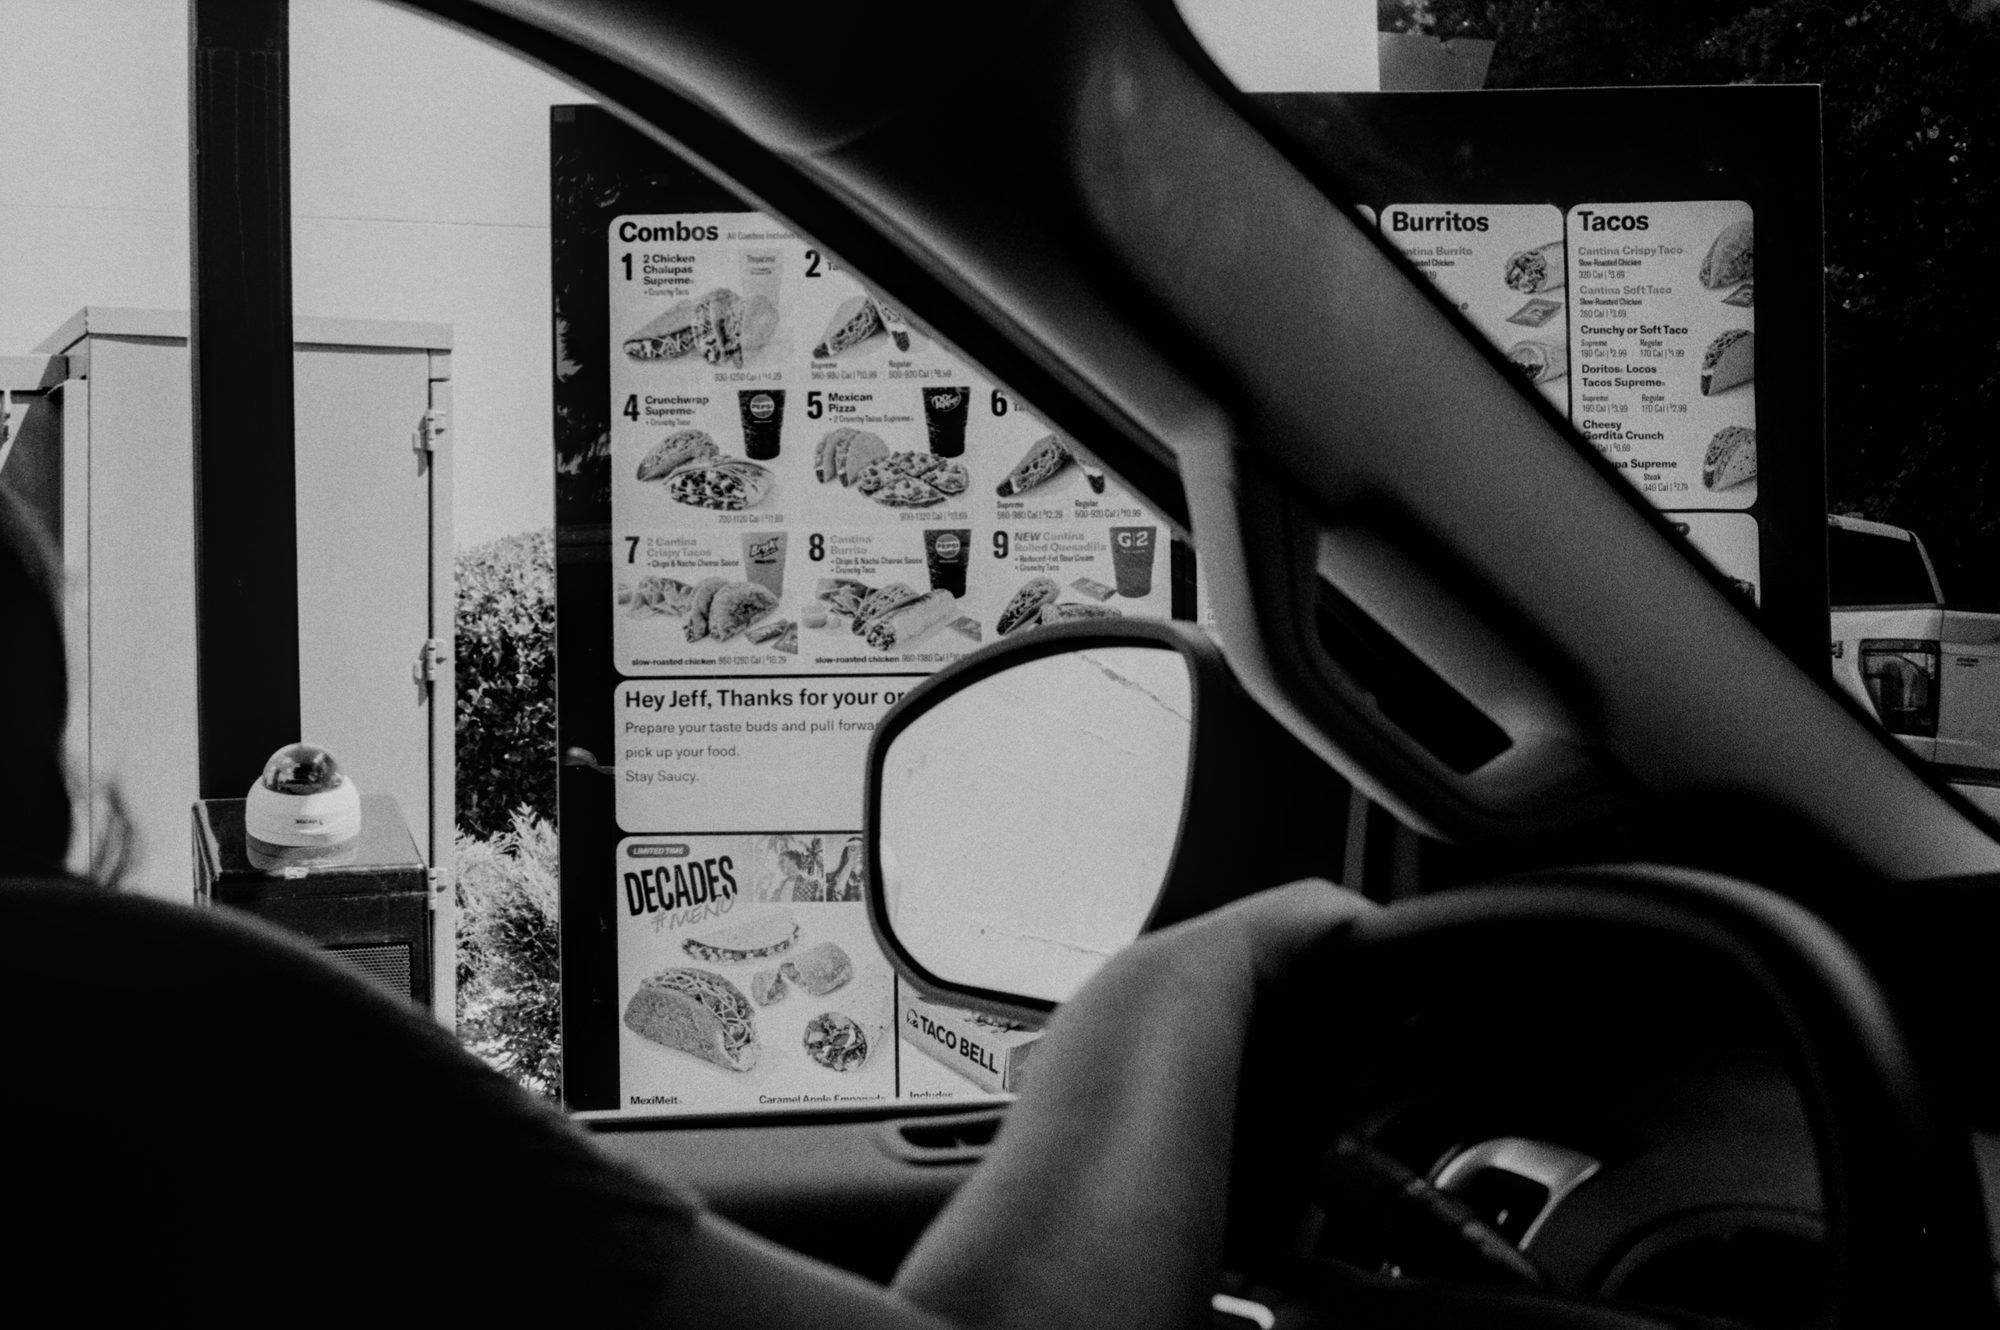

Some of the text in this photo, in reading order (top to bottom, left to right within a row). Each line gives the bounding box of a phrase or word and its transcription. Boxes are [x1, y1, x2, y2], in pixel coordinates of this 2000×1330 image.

[1392, 211, 1489, 232] Burritos
[1577, 211, 1649, 231] Tacos
[619, 221, 719, 243] Combos
[1436, 246, 1473, 255] Burrito
[1578, 245, 1683, 257] Cantina Crispy Taco
[643, 254, 696, 264] 2 Chicken
[805, 250, 822, 278] 2
[621, 253, 632, 281] 1
[643, 264, 693, 275] Chalupas
[643, 276, 691, 287] Supreme
[1580, 285, 1673, 295] Cantina Soft Taco
[1581, 325, 1688, 337] Crunchy or Soft Taco
[1582, 364, 1657, 374] Doritos Locos
[1582, 377, 1662, 389] Tacos Supreme
[645, 395, 709, 407] Crunchwrap
[828, 392, 873, 402] Mexican
[991, 389, 1008, 417] 6
[623, 393, 640, 421] 4
[645, 406, 692, 417] Supreme
[807, 391, 823, 420] 5
[828, 404, 857, 414] Pizza
[1583, 420, 1622, 431] Cheesy
[1625, 431, 1664, 441] Crunch
[1630, 459, 1677, 471] Supreme
[647, 537, 697, 547] 2 Cantina
[830, 535, 872, 545] Cantina
[1014, 531, 1085, 542] NEW Cantina
[624, 536, 640, 564] 7
[809, 533, 825, 562] 8
[830, 545, 868, 555] Burrito
[993, 530, 1009, 559] 9
[1015, 542, 1048, 553] Rolled
[1050, 541, 1107, 553] Quesadilla
[647, 548, 712, 559] Crispy Tacos
[631, 658, 683, 666] slow-roasted
[684, 658, 716, 666] chicken
[815, 656, 867, 664] slow-roasted
[868, 655, 900, 663] chicken
[625, 691, 665, 712] Hey
[668, 690, 713, 709] Jeff,
[717, 688, 793, 707] Thanks
[799, 688, 829, 706] for
[832, 692, 878, 710] your
[625, 721, 676, 736] Prepare
[678, 723, 707, 736] your
[709, 721, 743, 733] taste
[746, 720, 778, 733] buds
[781, 719, 806, 732] and
[810, 719, 834, 734] pull
[625, 745, 741, 761] pick up your food.
[625, 769, 700, 785] Stay Saucy.
[633, 846, 684, 855] LIMITED TIME
[624, 855, 738, 916] DECADES
[919, 1015, 1000, 1075] TACO BELL
[630, 1096, 679, 1105] MexiMelt
[759, 1095, 801, 1104] Caramel
